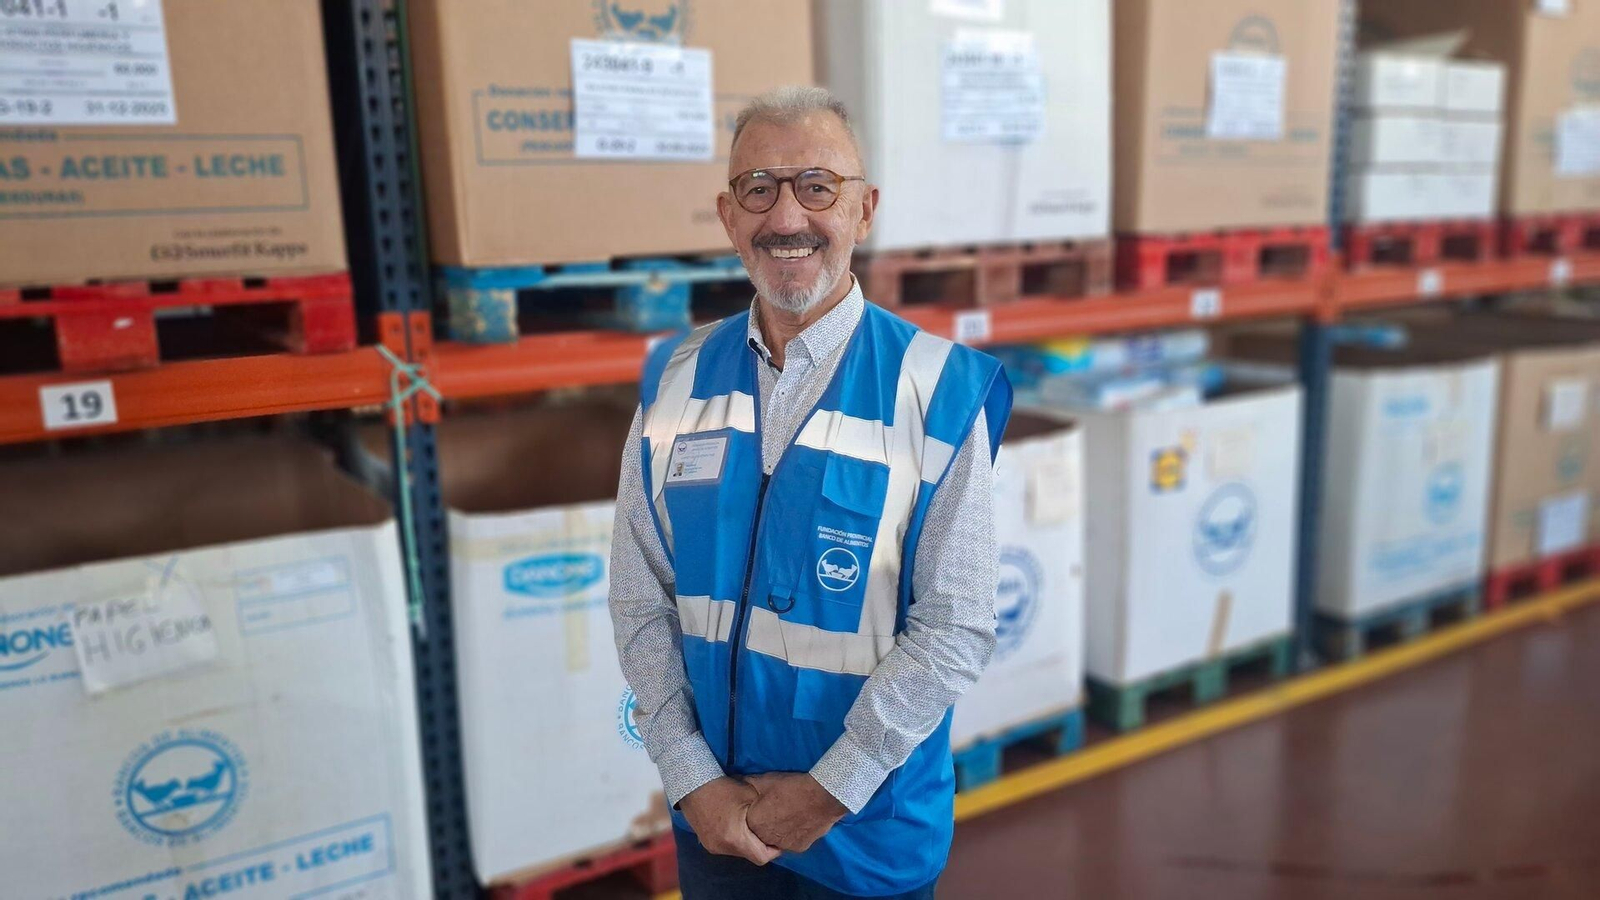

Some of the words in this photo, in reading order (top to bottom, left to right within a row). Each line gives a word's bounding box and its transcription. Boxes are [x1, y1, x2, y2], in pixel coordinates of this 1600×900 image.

[60, 153, 169, 180] ACEITE
[193, 152, 286, 178] LECHE
[60, 389, 104, 421] 19
[184, 860, 277, 900] ACEITE
[295, 833, 375, 871] LECHE
